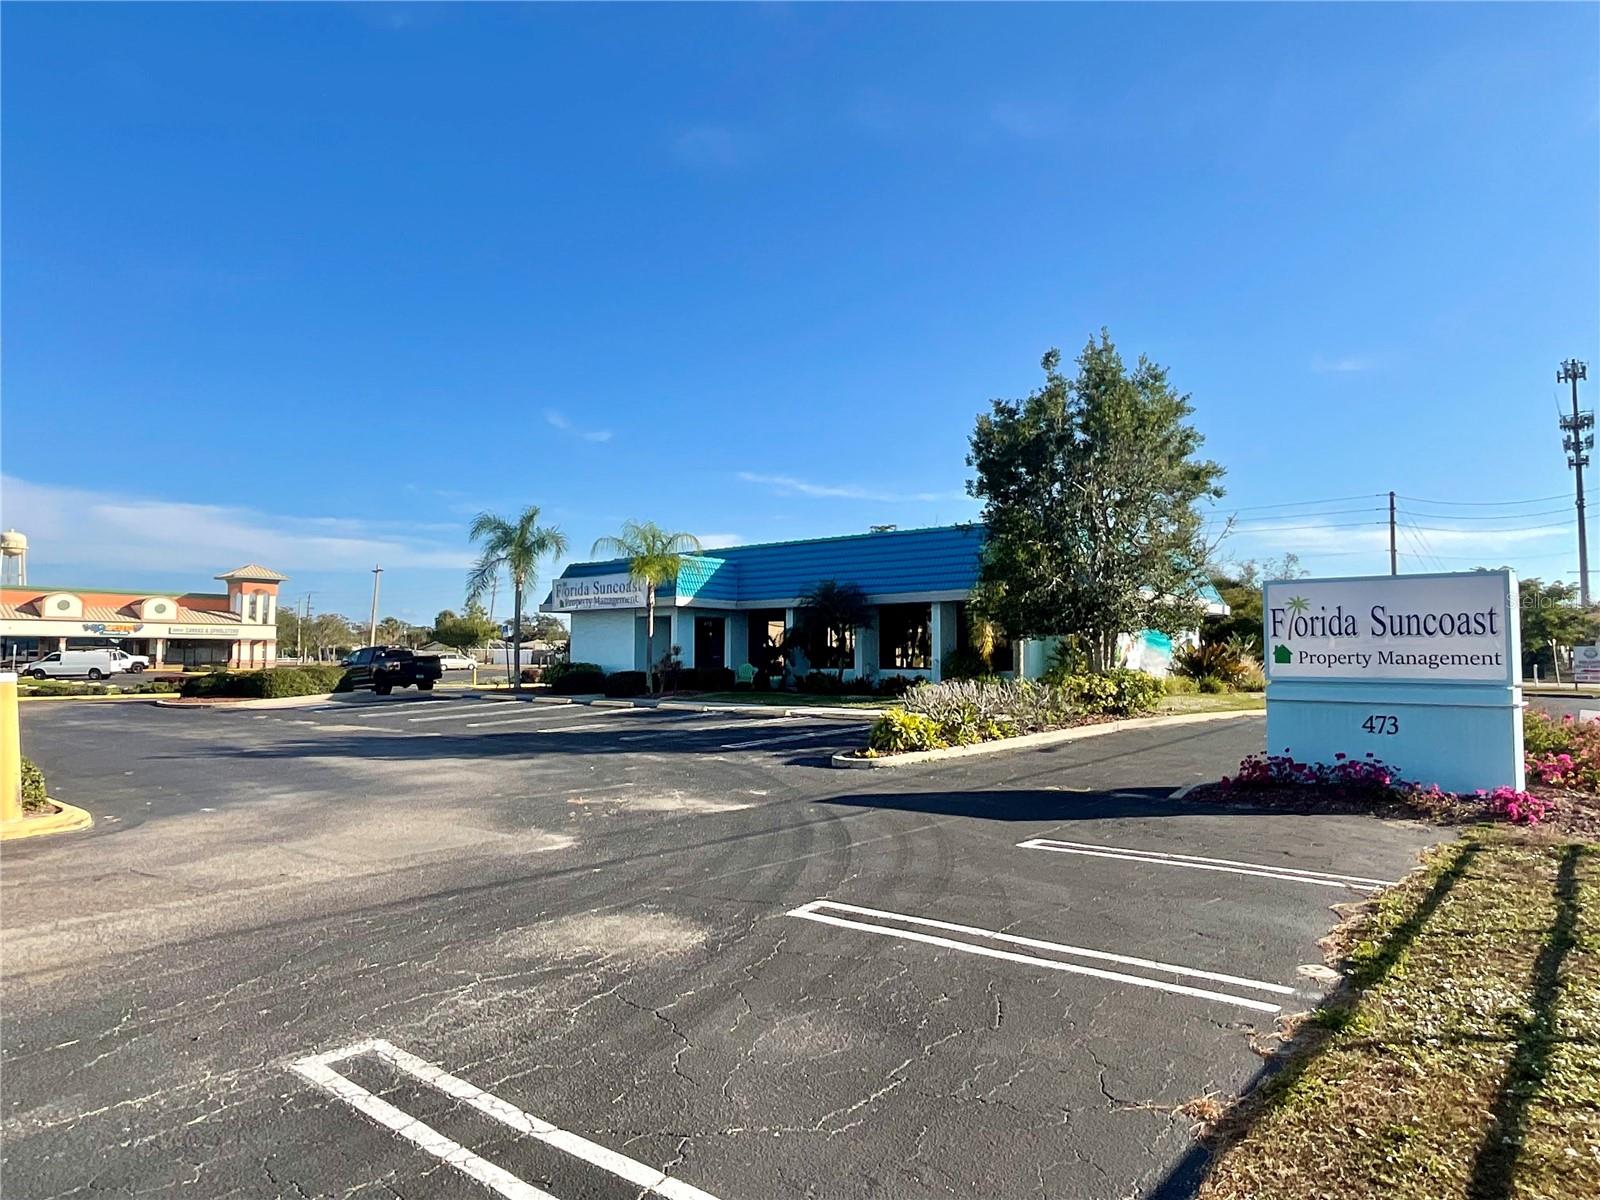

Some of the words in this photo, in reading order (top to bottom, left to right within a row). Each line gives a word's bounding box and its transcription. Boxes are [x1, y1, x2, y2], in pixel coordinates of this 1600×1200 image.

[556, 580, 589, 598] Florida
[593, 579, 641, 595] Suncoast
[1270, 602, 1358, 640] Florida
[1371, 604, 1498, 637] Suncoast
[1298, 650, 1372, 668] Property
[1377, 650, 1502, 669] Management
[1361, 715, 1399, 735] 473
